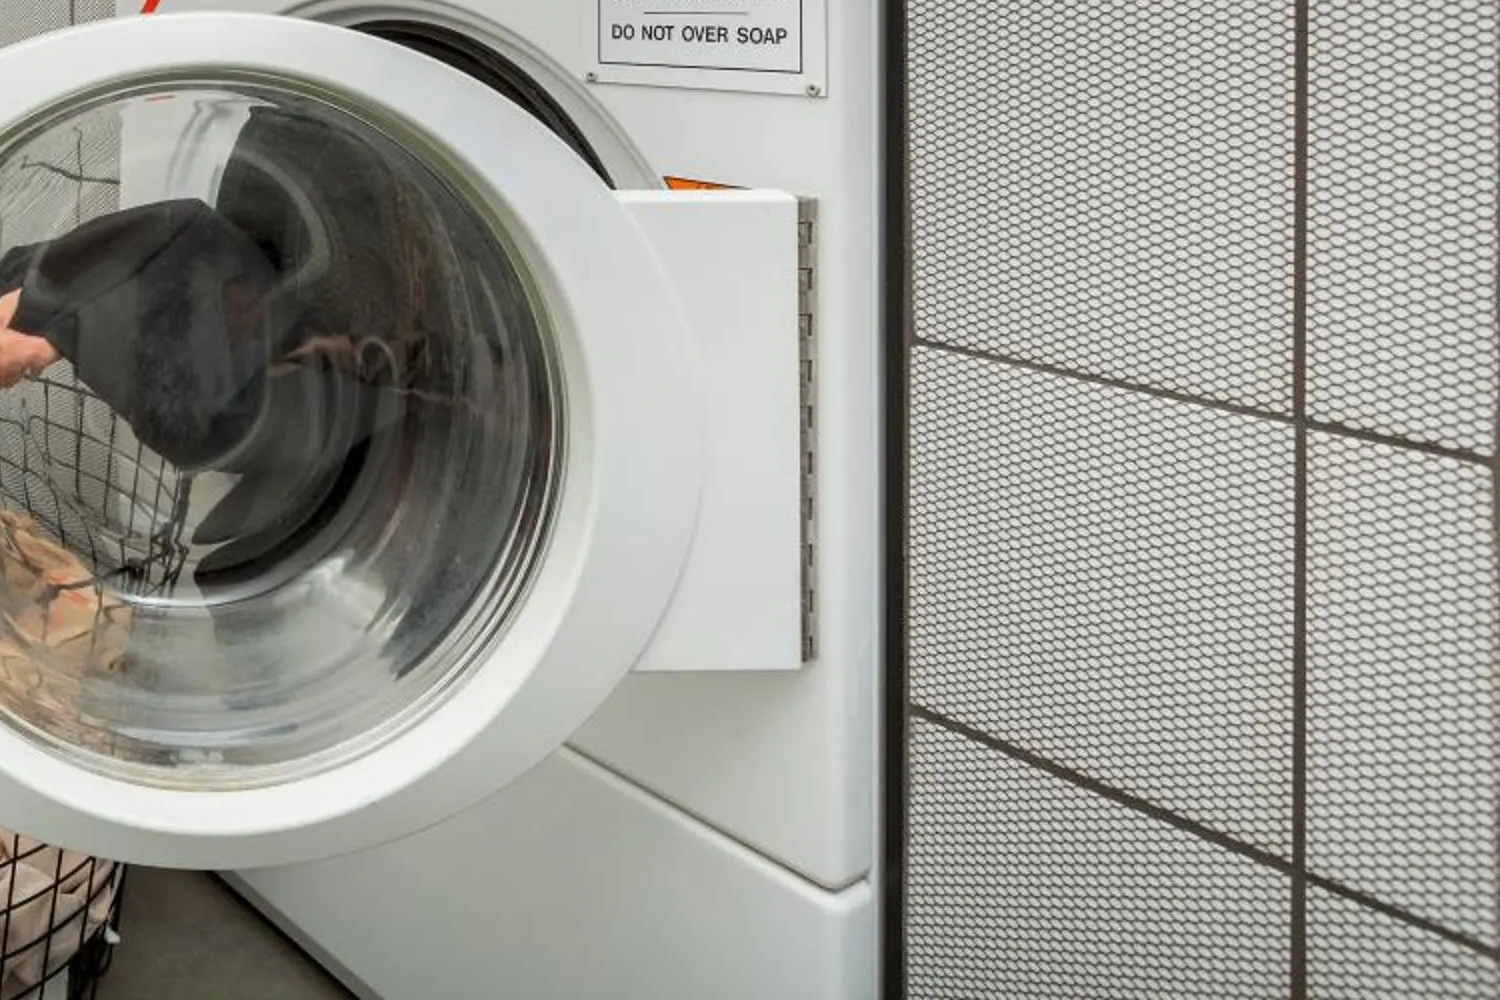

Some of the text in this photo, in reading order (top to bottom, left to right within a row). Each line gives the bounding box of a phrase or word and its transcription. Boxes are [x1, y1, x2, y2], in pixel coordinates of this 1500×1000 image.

[612, 24, 787, 45] DO NOT OVER SOAP
